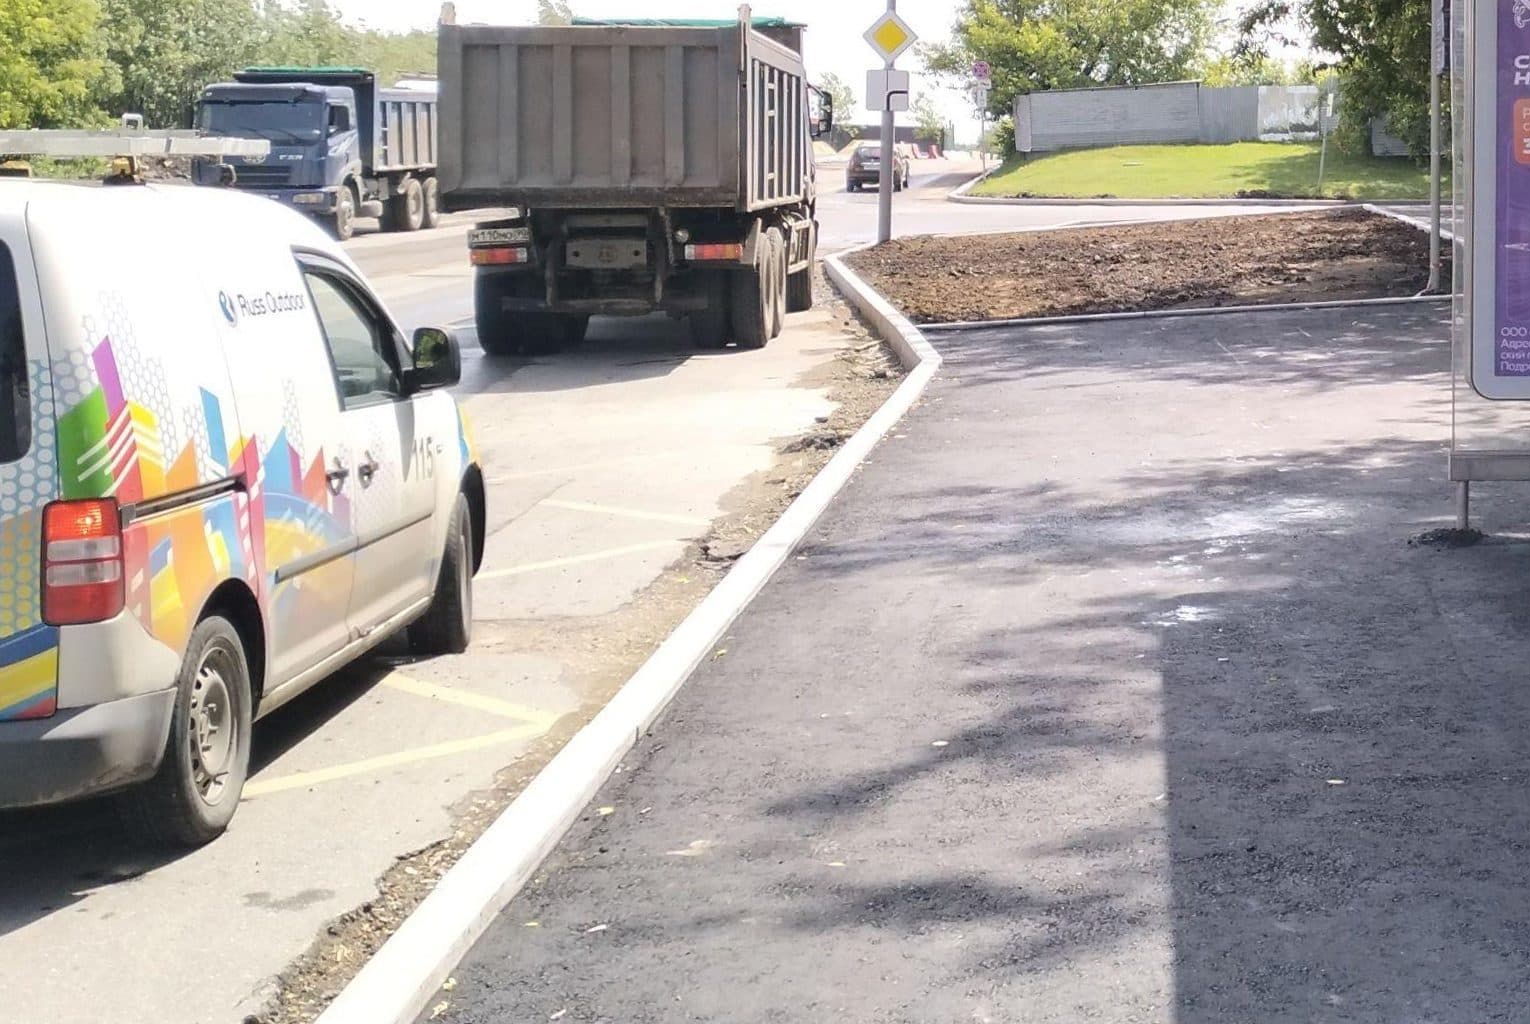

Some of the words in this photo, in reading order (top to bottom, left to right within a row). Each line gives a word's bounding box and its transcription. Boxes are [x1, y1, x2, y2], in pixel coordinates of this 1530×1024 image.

[1522, 123, 1530, 132] с
[237, 294, 266, 317] Russ
[1501, 327, 1528, 337] ООО
